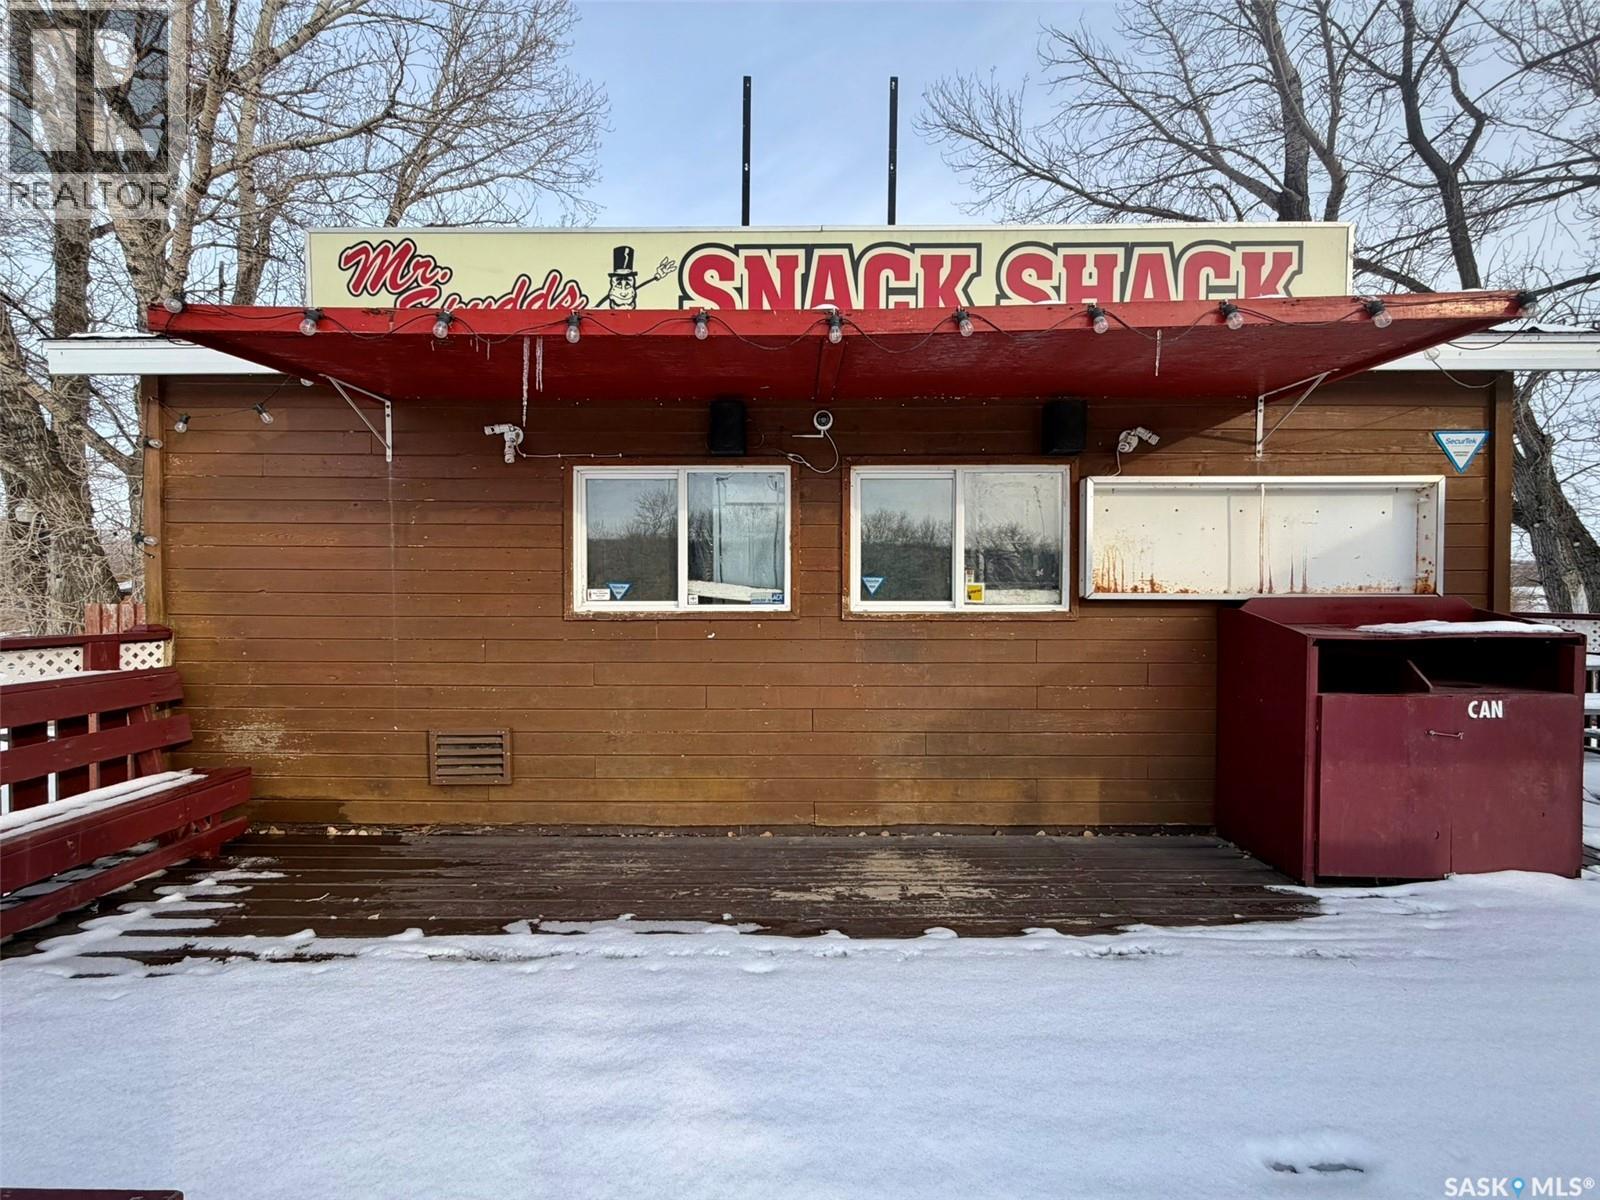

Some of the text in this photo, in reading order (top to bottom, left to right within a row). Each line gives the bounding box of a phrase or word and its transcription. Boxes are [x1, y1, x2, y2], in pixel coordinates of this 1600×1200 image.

[339, 239, 451, 296] Mr.
[680, 240, 1301, 310] SNACK SHACK
[1468, 700, 1503, 718] CAN
